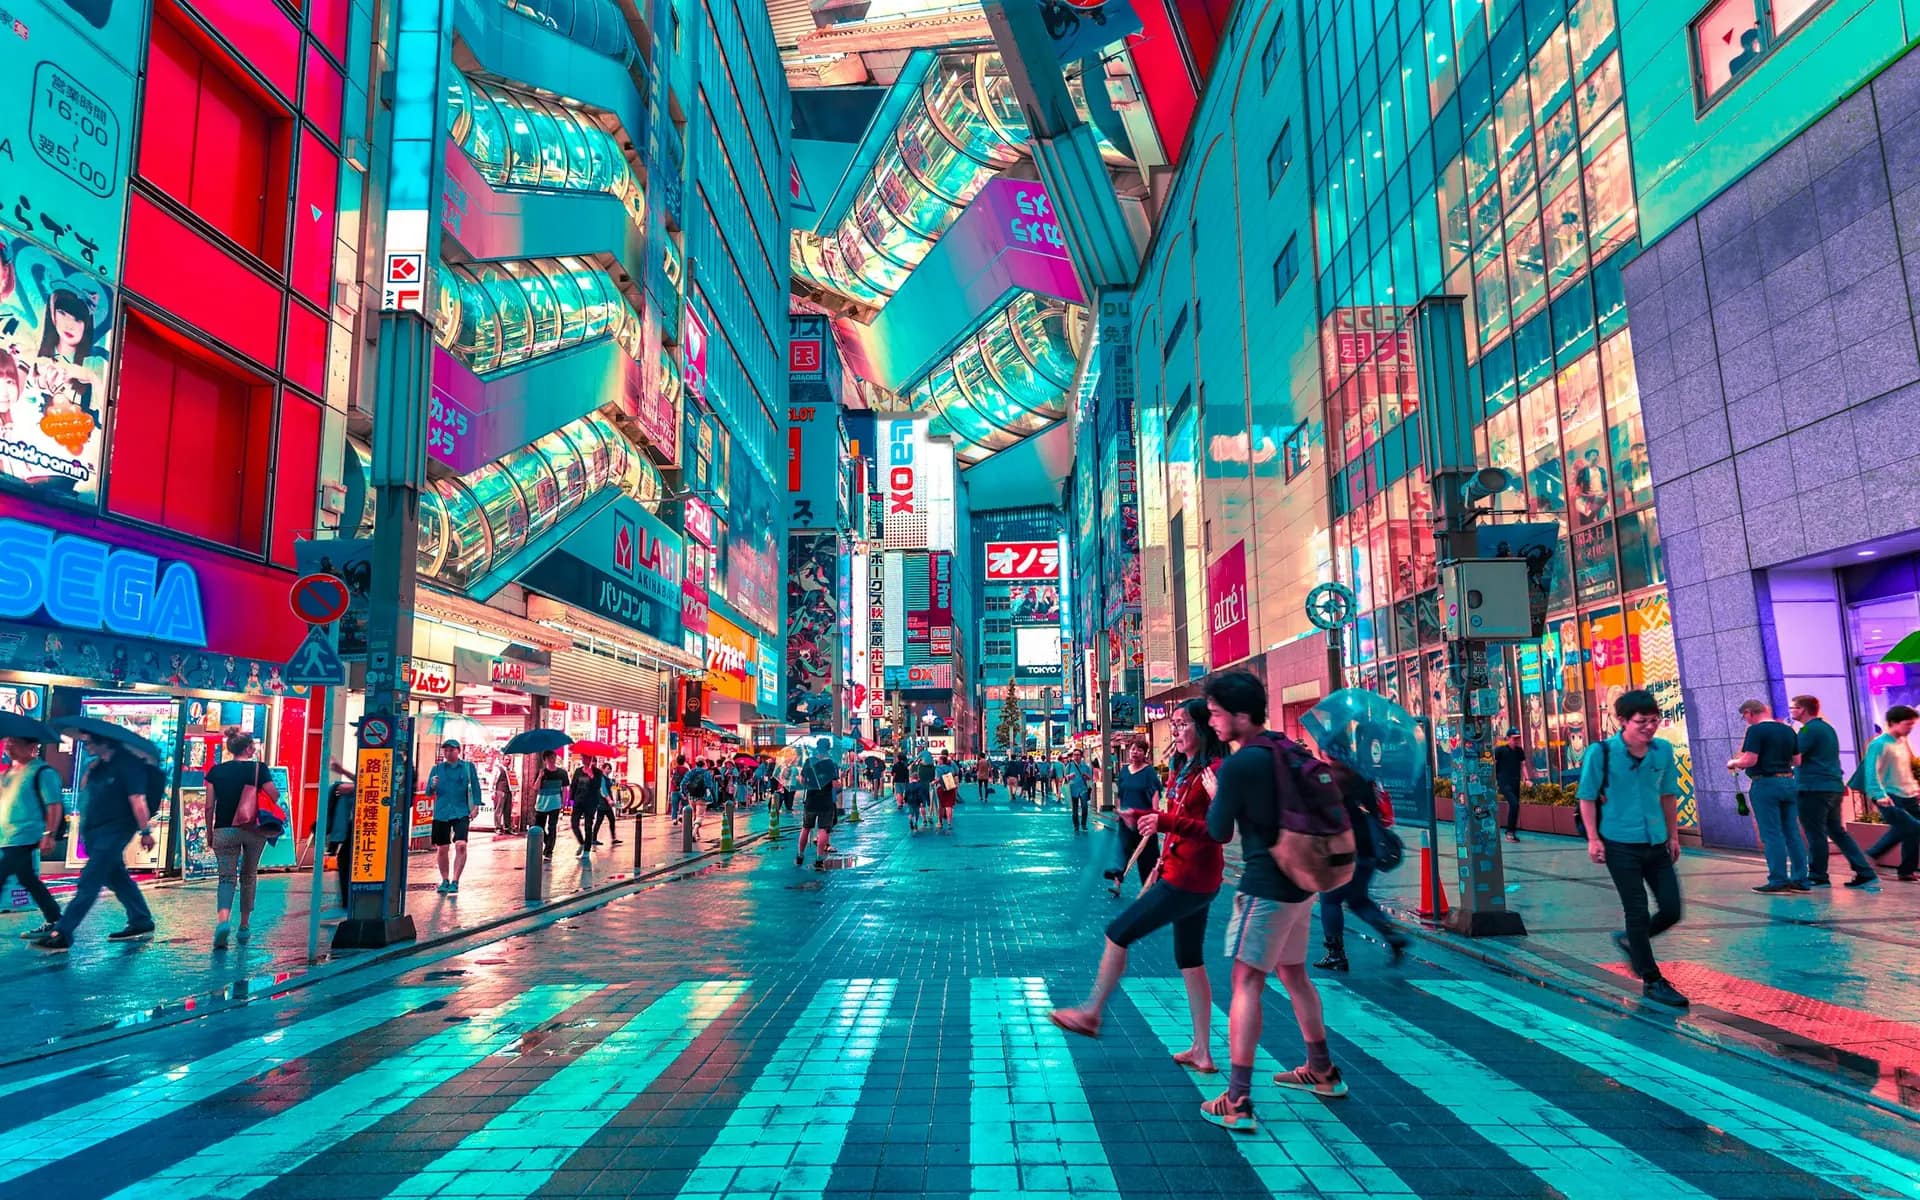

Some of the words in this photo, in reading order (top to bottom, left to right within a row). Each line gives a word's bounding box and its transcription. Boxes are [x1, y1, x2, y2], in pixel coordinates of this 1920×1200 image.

[46, 88, 108, 147] 16:00
[38, 133, 106, 191] 翌5:00
[430, 395, 468, 437] カメラ
[429, 424, 456, 456] メラ
[638, 526, 680, 587] LABI
[0, 517, 207, 647] SEGA
[937, 583, 950, 608] Free
[1214, 584, 1239, 631] atré
[503, 663, 525, 681] LABI
[1027, 666, 1057, 674] TOKYO
[361, 758, 381, 877] 路上喫煙禁止です。
[417, 799, 434, 812] au
